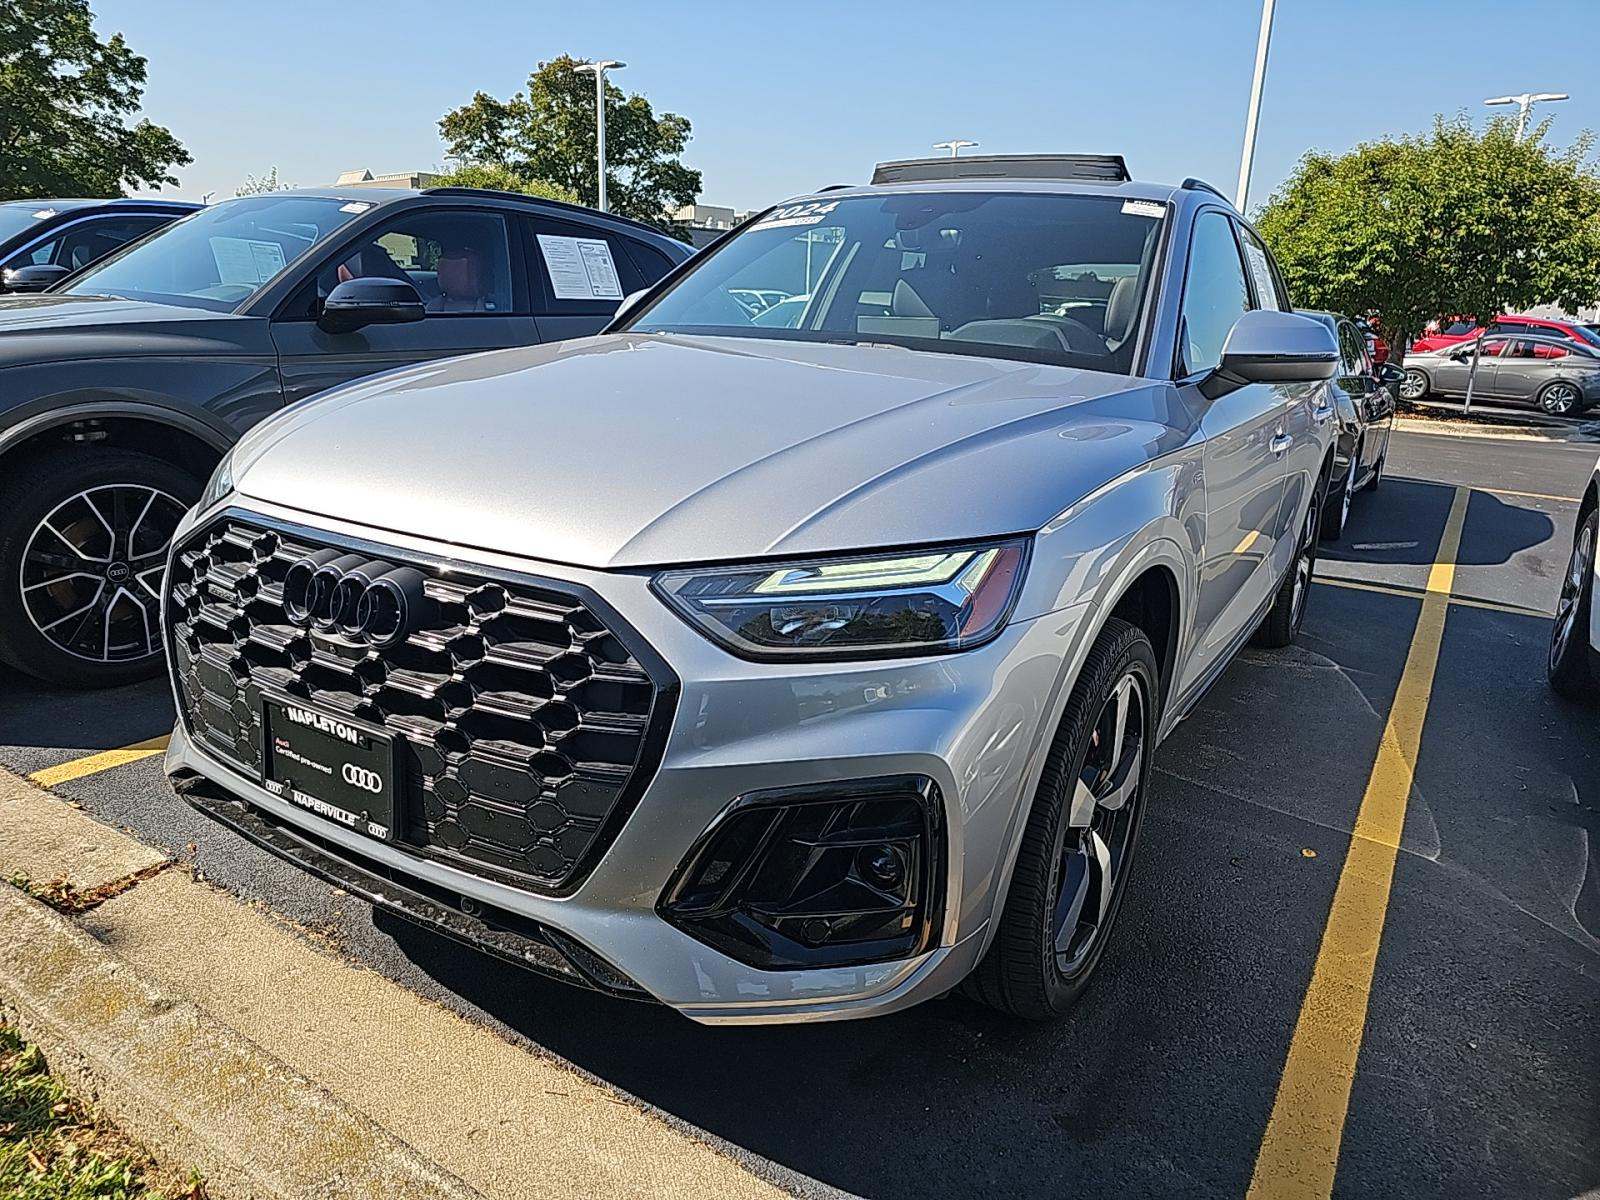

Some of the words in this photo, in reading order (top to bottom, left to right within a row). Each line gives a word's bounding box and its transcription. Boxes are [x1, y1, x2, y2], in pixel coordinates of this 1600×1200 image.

[286, 707, 358, 745] NAPLETON
[275, 737, 290, 748] Audi
[275, 746, 301, 762] Certified
[300, 757, 333, 775] pre-owned
[293, 791, 356, 827] NAPERVILLE
